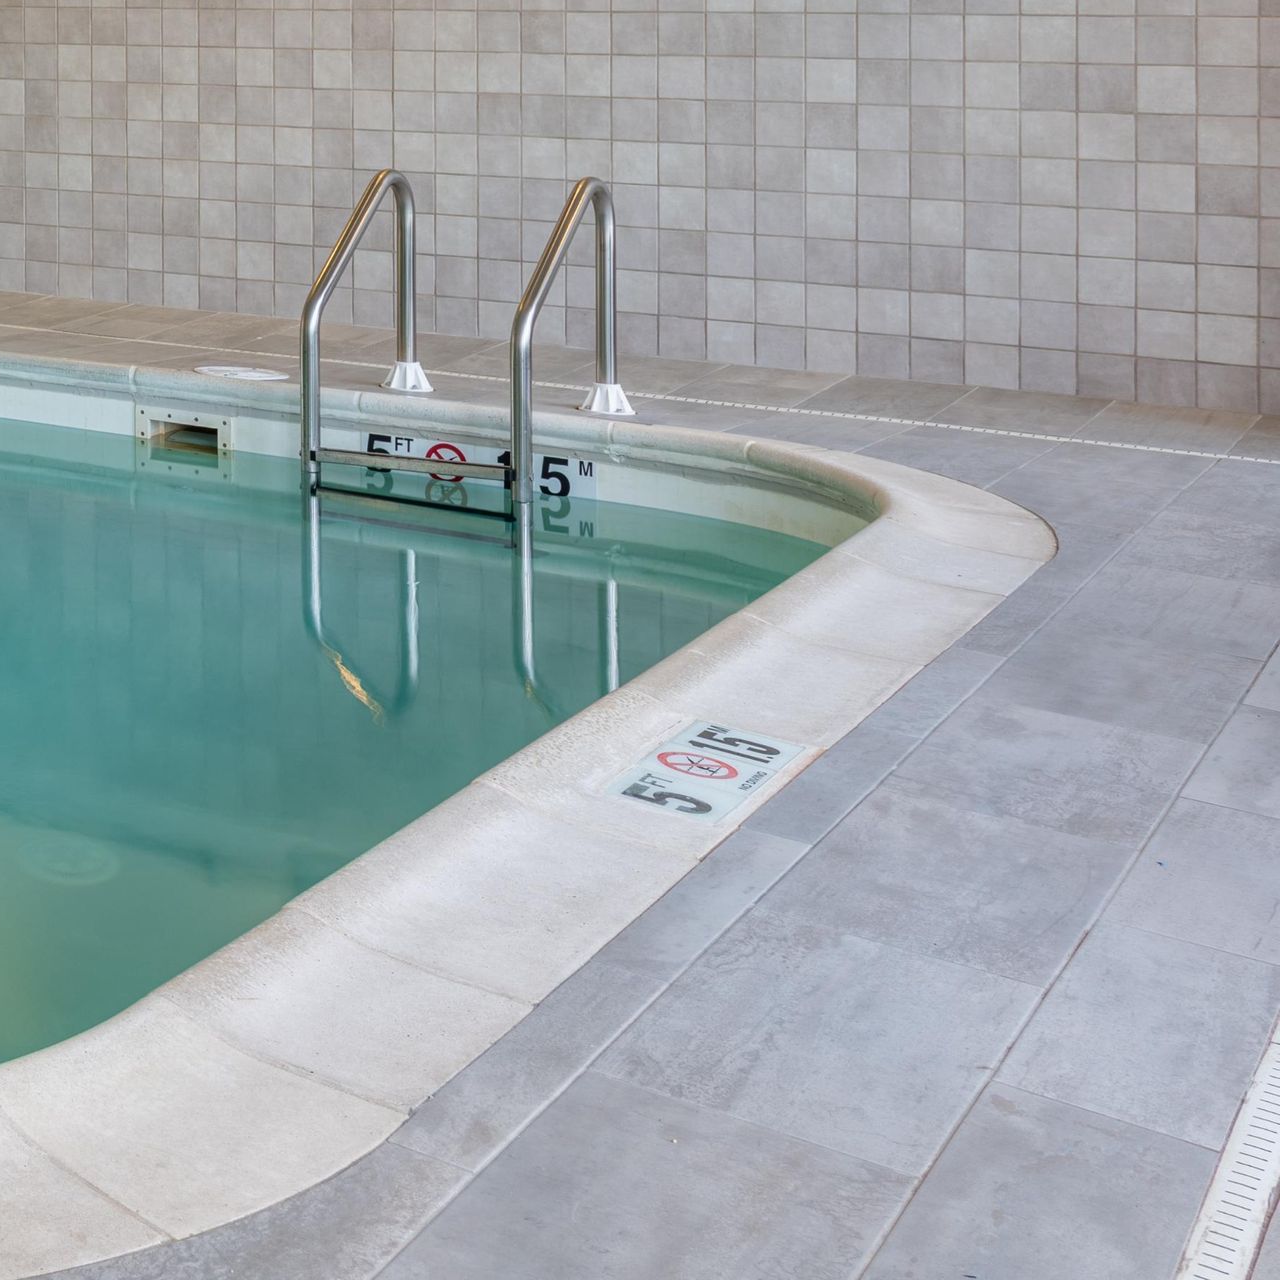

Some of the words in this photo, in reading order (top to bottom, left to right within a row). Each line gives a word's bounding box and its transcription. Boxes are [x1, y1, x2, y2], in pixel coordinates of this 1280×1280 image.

[394, 437, 414, 453] FT
[579, 461, 593, 477] M
[621, 782, 712, 814] 5
